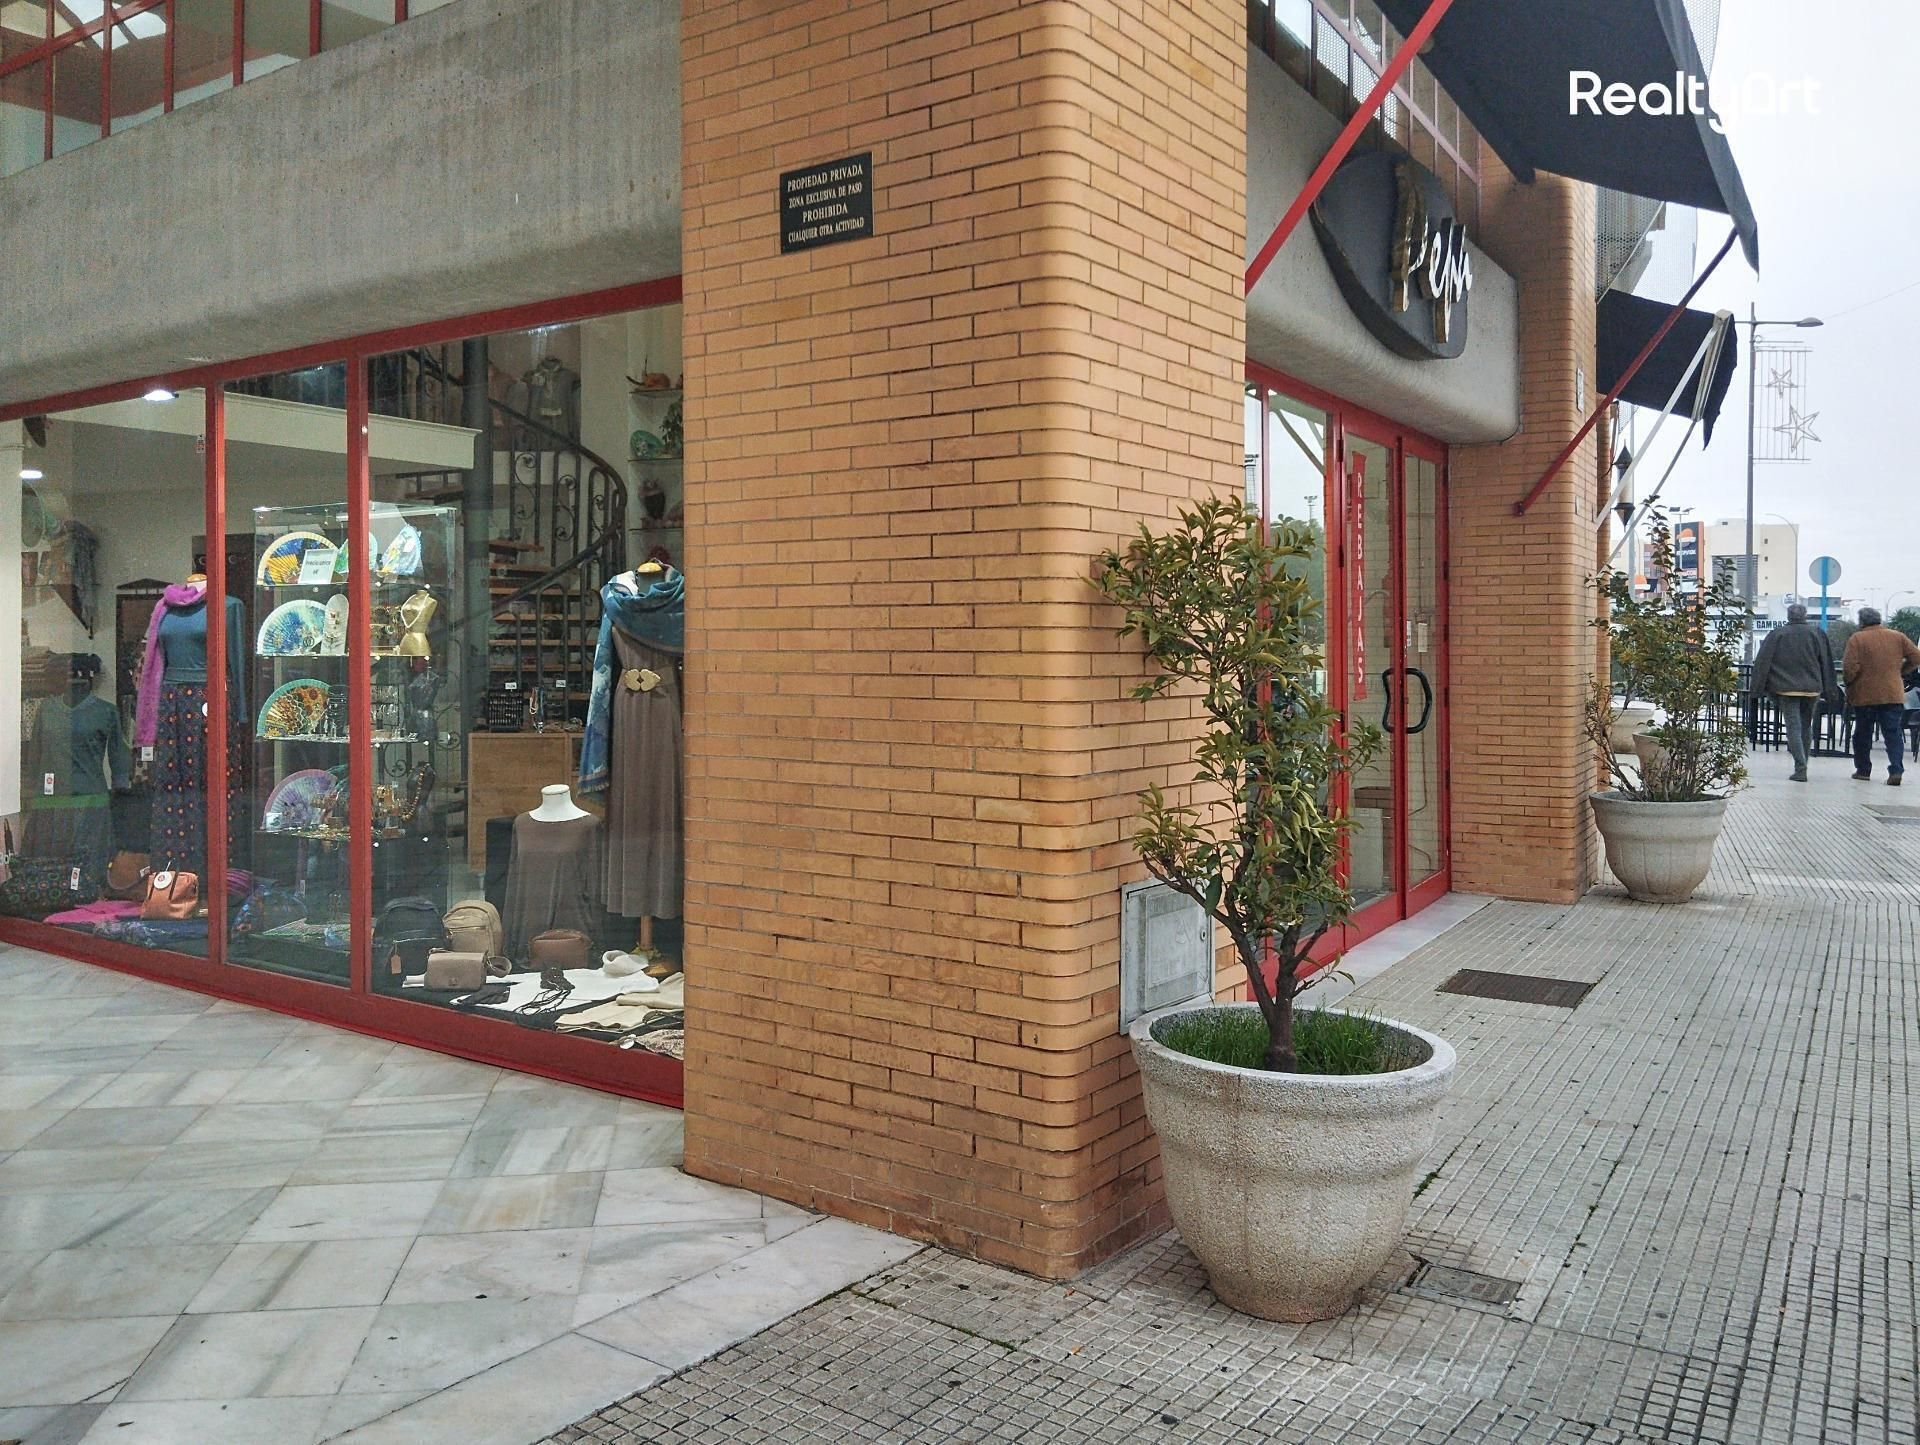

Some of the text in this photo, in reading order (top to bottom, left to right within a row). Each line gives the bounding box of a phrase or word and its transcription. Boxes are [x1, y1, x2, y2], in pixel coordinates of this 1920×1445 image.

[788, 163, 863, 192] PROPIEDAD PRIVADA
[788, 182, 862, 209] ZONA EXCLUSIVA DE PASO
[802, 202, 848, 223] PROHIBIDA
[788, 217, 864, 243] CUALQUIER OTRA ACTIVIDAD
[1756, 620, 1787, 629] GAMBAS
